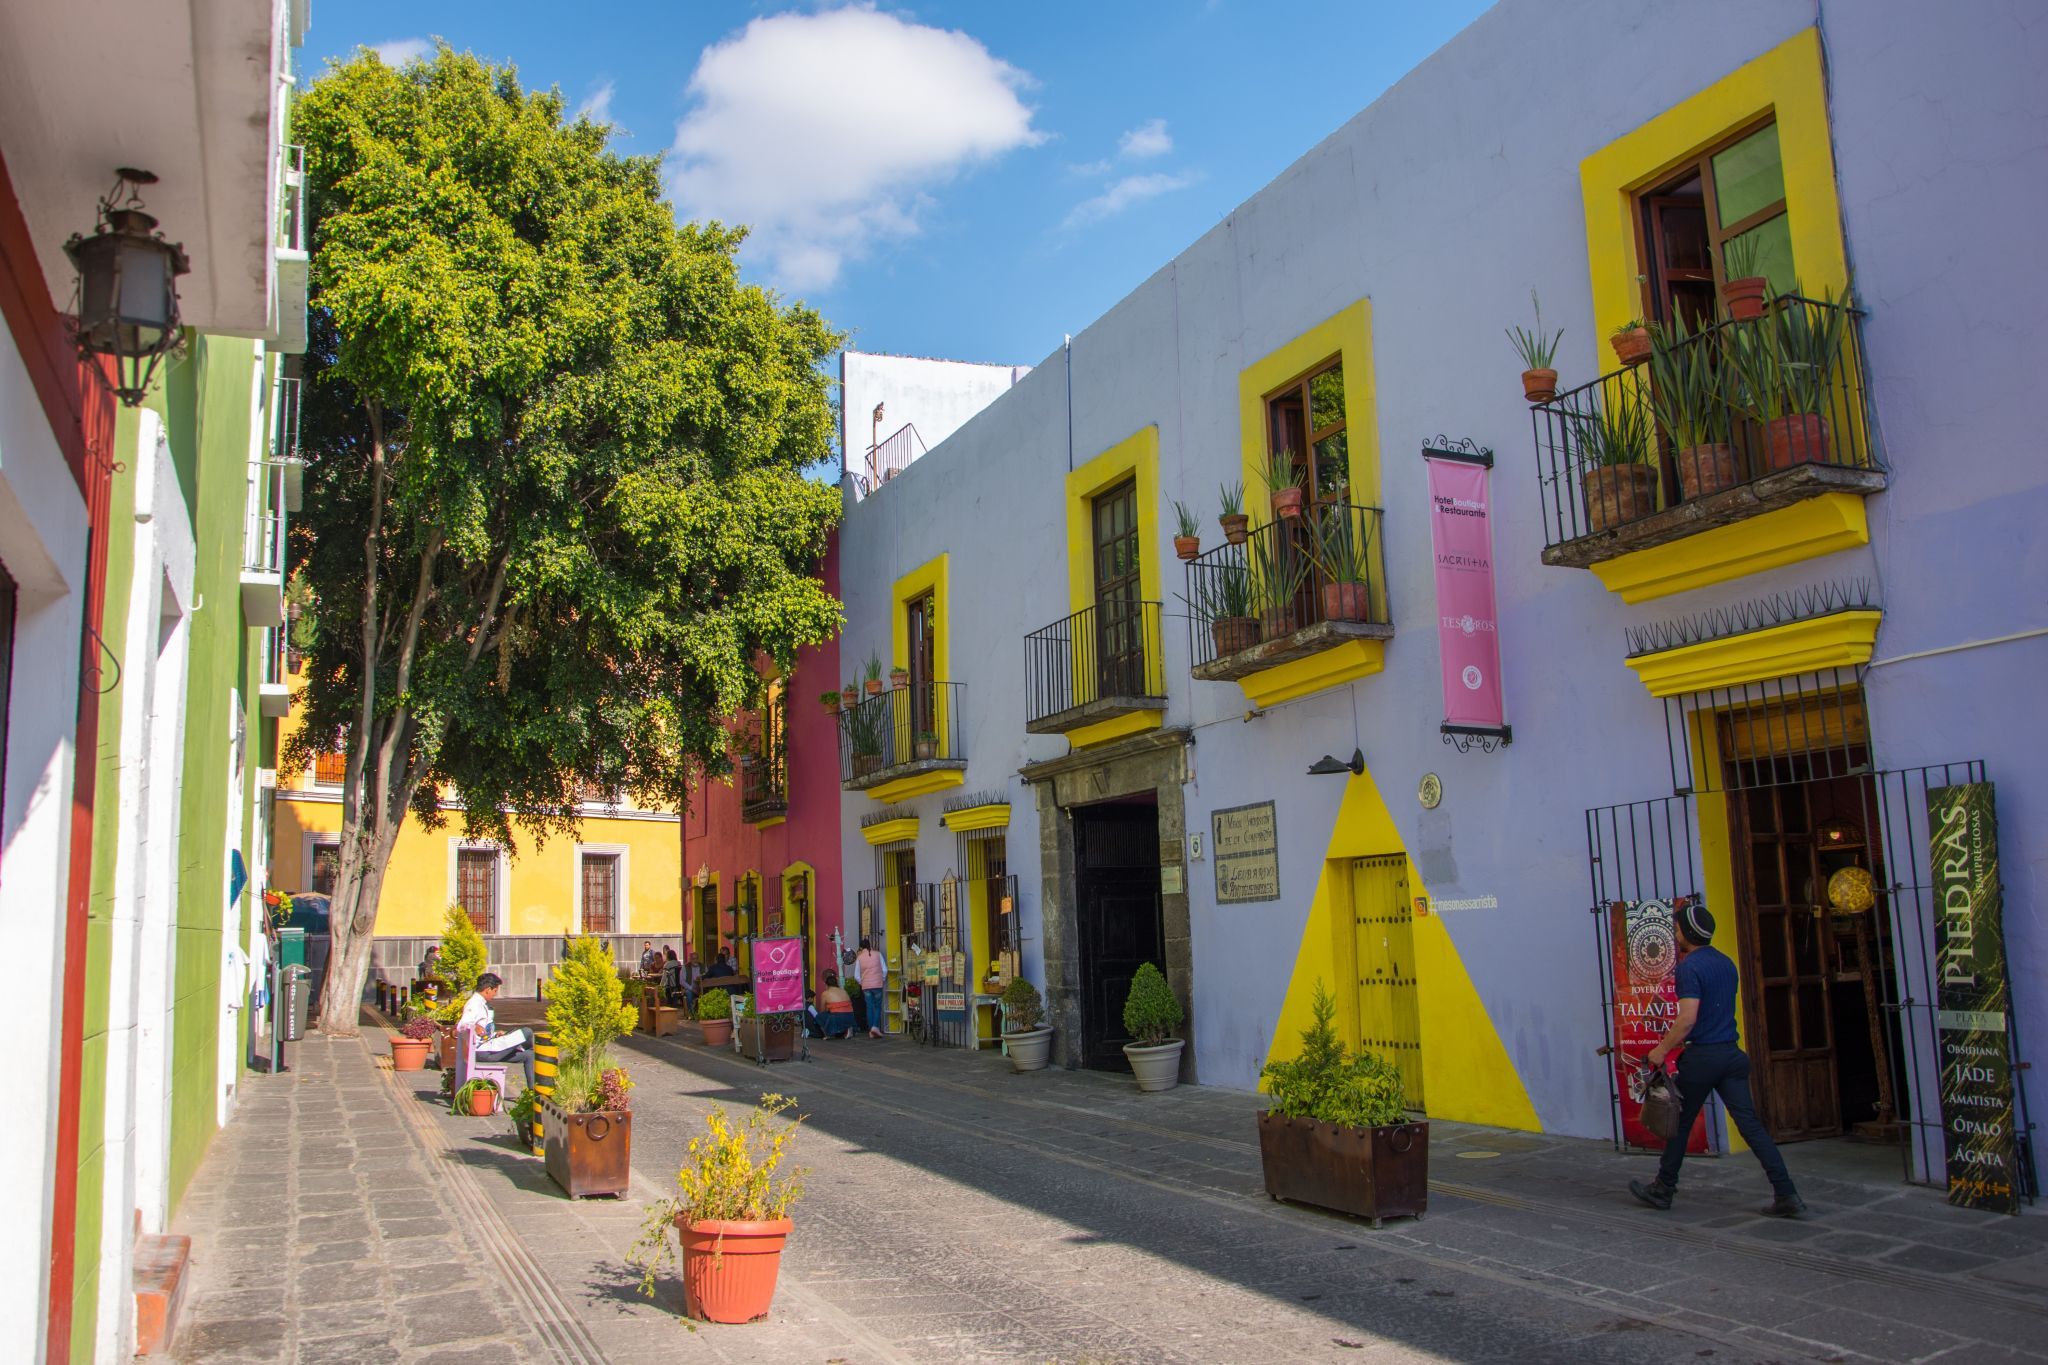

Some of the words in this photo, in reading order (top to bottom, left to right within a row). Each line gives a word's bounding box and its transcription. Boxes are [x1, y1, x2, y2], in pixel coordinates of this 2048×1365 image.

[1971, 809, 1985, 895] SEMIPRECIOSAS
[1941, 805, 1976, 988] PIEDRAS
[1631, 1020, 1639, 1033] Y
[1947, 1044, 2000, 1057] OBSIDIANA
[1956, 1063, 1995, 1083] JÁDE
[1949, 1093, 2003, 1108] AMATISTA
[1954, 1115, 2001, 1137] ÓPALO
[1954, 1144, 2003, 1167] ÁGATA
